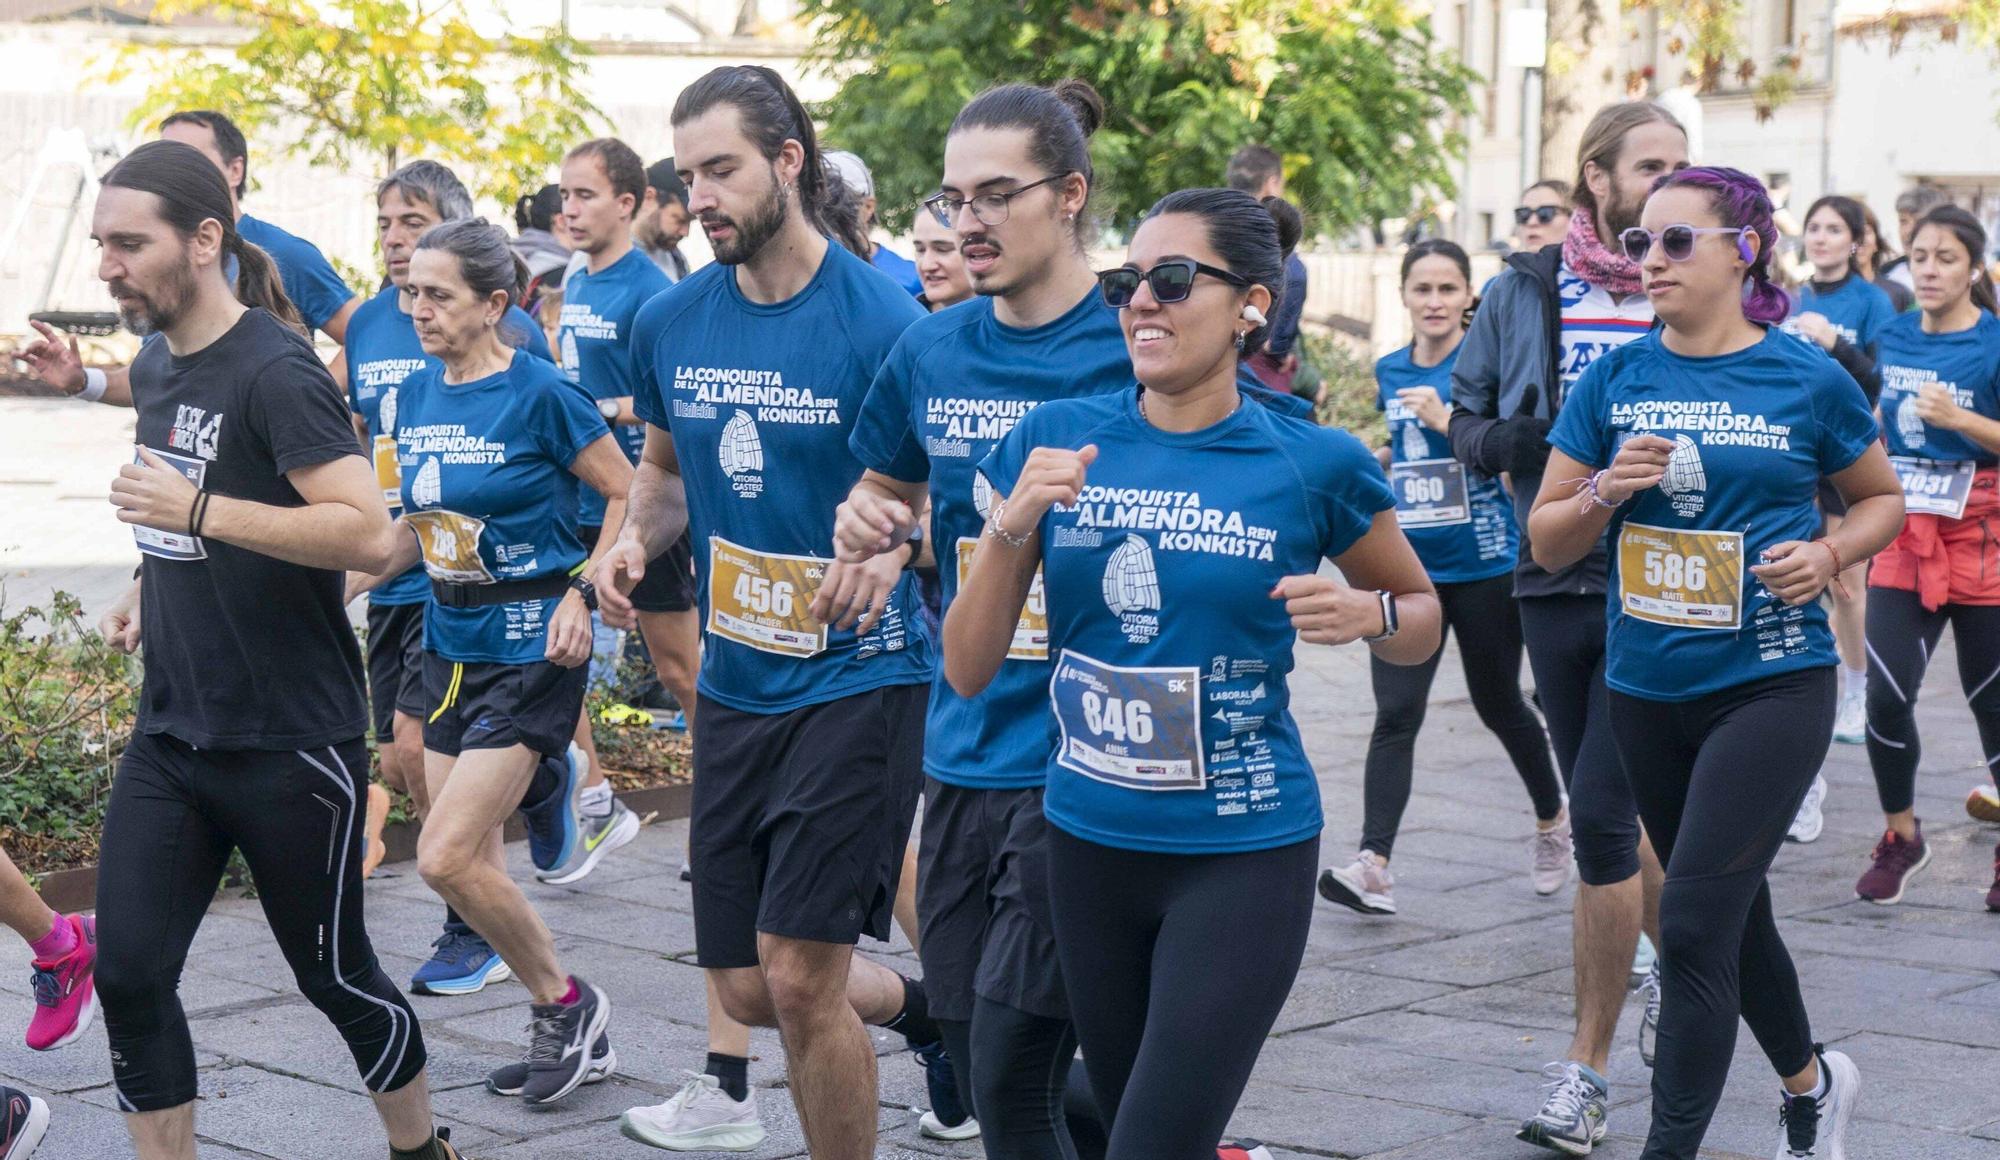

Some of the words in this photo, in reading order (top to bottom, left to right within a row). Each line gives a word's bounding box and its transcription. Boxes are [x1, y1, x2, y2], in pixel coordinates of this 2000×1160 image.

[675, 366, 694, 380] LA
[694, 367, 782, 387] CONQUISTA
[674, 380, 686, 389] DE
[687, 381, 699, 390] LA
[695, 382, 816, 408] ALMENDRA
[815, 398, 838, 409] REN
[758, 407, 841, 425] KONKISTA
[927, 397, 943, 414] LA
[943, 398, 1044, 419] CONQUIST
[1612, 403, 1633, 416] LA
[1633, 401, 1732, 416] CONQUISTA
[399, 426, 413, 438] LA
[413, 424, 466, 438] CONQUISTA
[945, 416, 1020, 440] ALME
[1611, 415, 1625, 425] DE
[1632, 413, 1769, 434] ALMENDRA
[1768, 424, 1791, 436] REN
[409, 436, 486, 454] ALMENDRA
[1702, 431, 1791, 451] KONKISTA
[442, 452, 505, 464] KONKISTA
[732, 475, 763, 484] VITORIA
[732, 483, 764, 493] GASTEIZ
[1902, 472, 1953, 495] 1031
[1076, 485, 1201, 509] CONQUISTA
[1404, 476, 1444, 504] 960
[1672, 494, 1704, 504] VITORIA
[1672, 502, 1704, 513] GASTEIZ
[1076, 503, 1246, 537] ALMENDRA
[1246, 526, 1278, 543] REN
[1158, 531, 1275, 562] KONKISTA
[1717, 541, 1735, 552] 10K
[804, 567, 824, 580] 10K
[1644, 551, 1707, 591] 586
[733, 571, 794, 618] 456
[1661, 590, 1685, 602] MAITE
[740, 612, 755, 624] JON
[756, 615, 784, 629] ANDER
[1121, 613, 1159, 626] VITORIA
[1121, 623, 1160, 636] GASTEIZ
[1167, 679, 1188, 693] 5K
[1210, 690, 1251, 702] LABORAL
[1082, 691, 1154, 744] 846
[1105, 743, 1130, 757] ANNE
